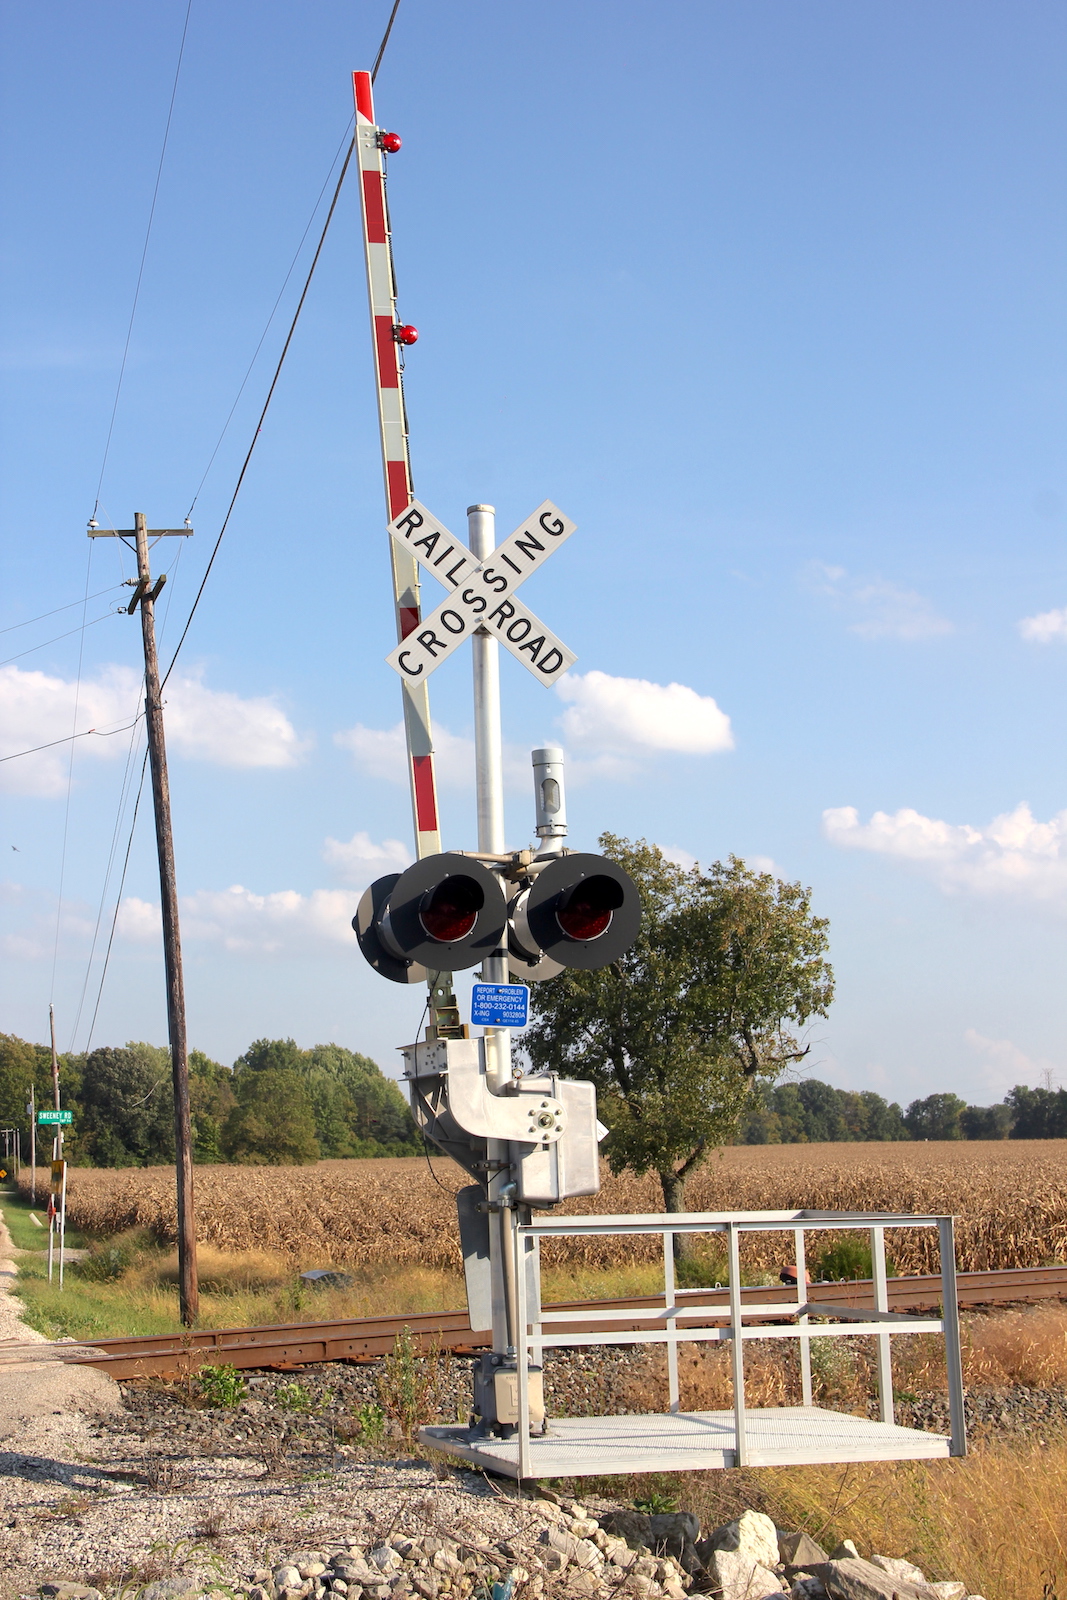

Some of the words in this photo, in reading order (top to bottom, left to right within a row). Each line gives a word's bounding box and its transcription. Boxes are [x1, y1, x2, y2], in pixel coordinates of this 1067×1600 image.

[396, 508, 467, 587] RAIL
[488, 599, 563, 674] ROAD
[398, 512, 565, 676] CROSSING
[473, 1002, 525, 1010] 1-800-232-0144
[487, 994, 523, 1002] EMERGENCY
